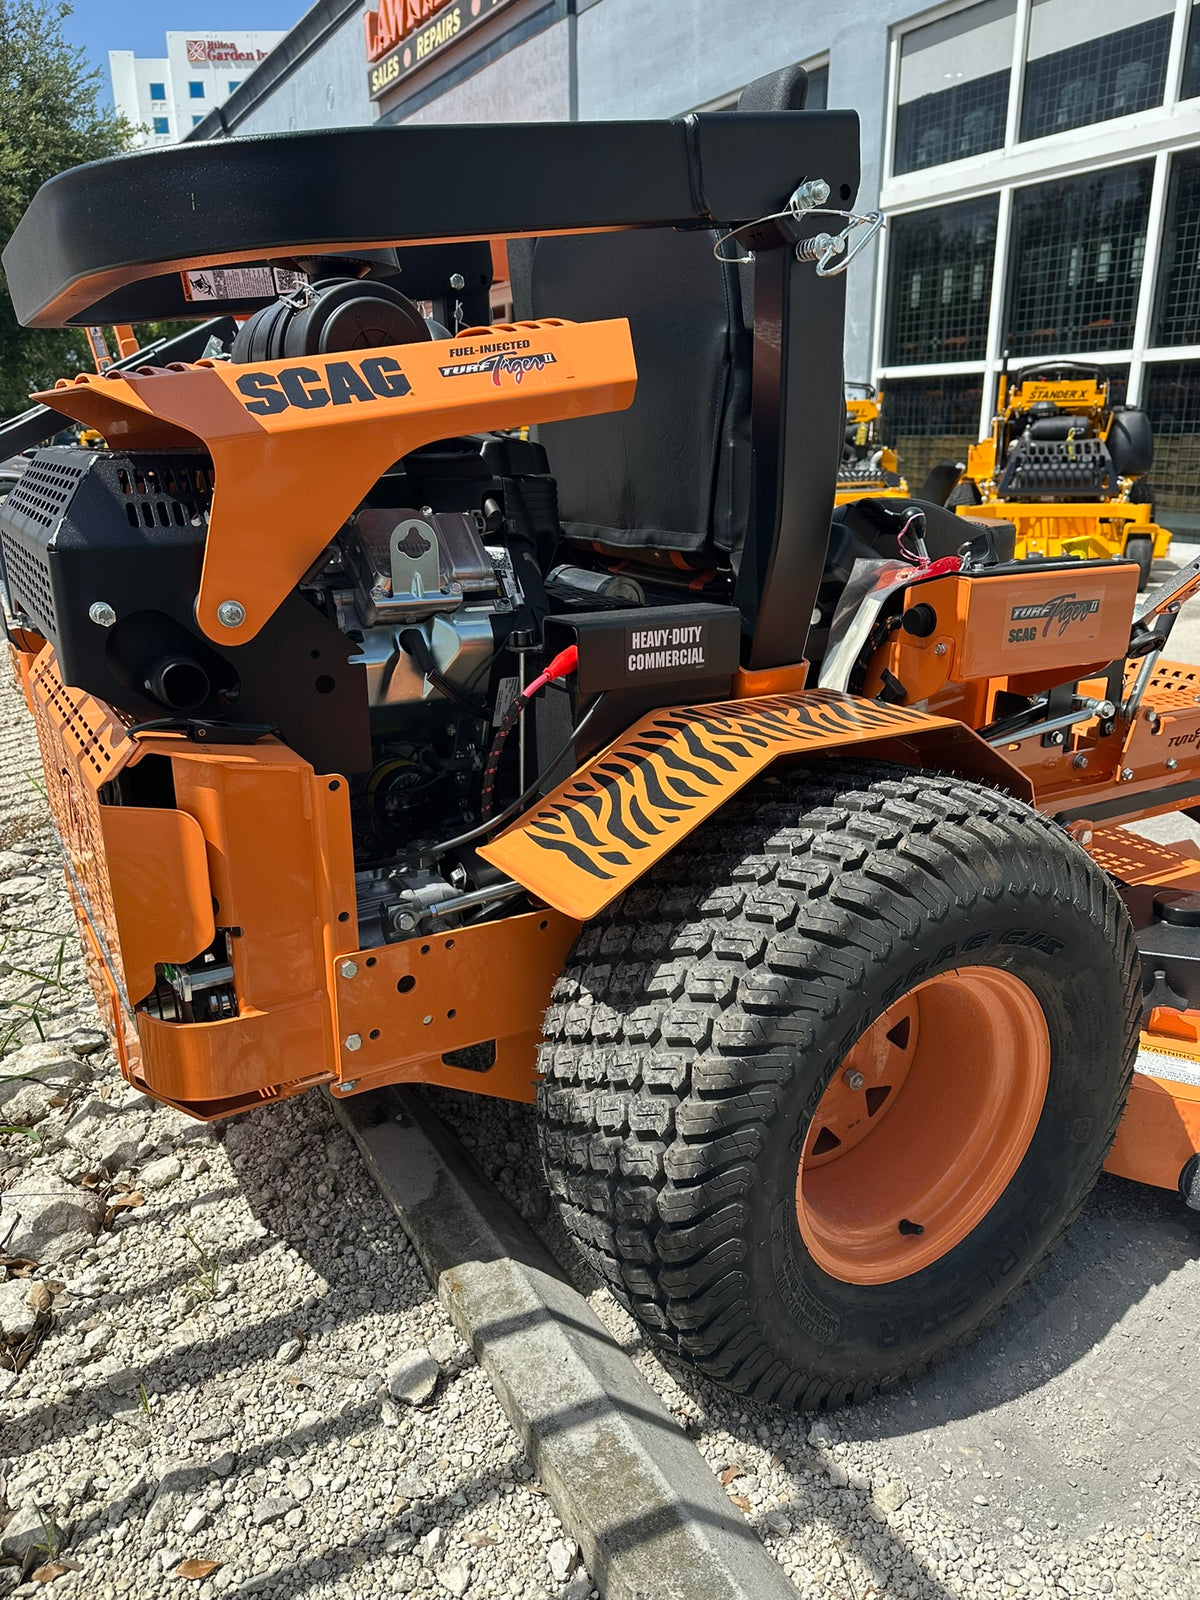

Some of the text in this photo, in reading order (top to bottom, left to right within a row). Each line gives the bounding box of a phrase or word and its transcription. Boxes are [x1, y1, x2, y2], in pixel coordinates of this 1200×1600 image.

[207, 41, 236, 49] Hilton
[207, 48, 254, 61] Garden
[372, 8, 460, 91] SALES REPAIRS
[449, 340, 530, 357] FUEL-INJECTED
[441, 361, 490, 377] TURF
[477, 351, 546, 387] Tiger
[236, 356, 412, 415] SCAG
[1029, 389, 1088, 399] STANDER X
[1012, 603, 1052, 619] TURF
[1042, 593, 1089, 638] Tiger
[632, 626, 702, 649] HEAVY-DUTY
[1008, 626, 1037, 643] SCAG
[628, 647, 705, 671] COMMERCIAL
[1141, 1045, 1195, 1060] WARNING
